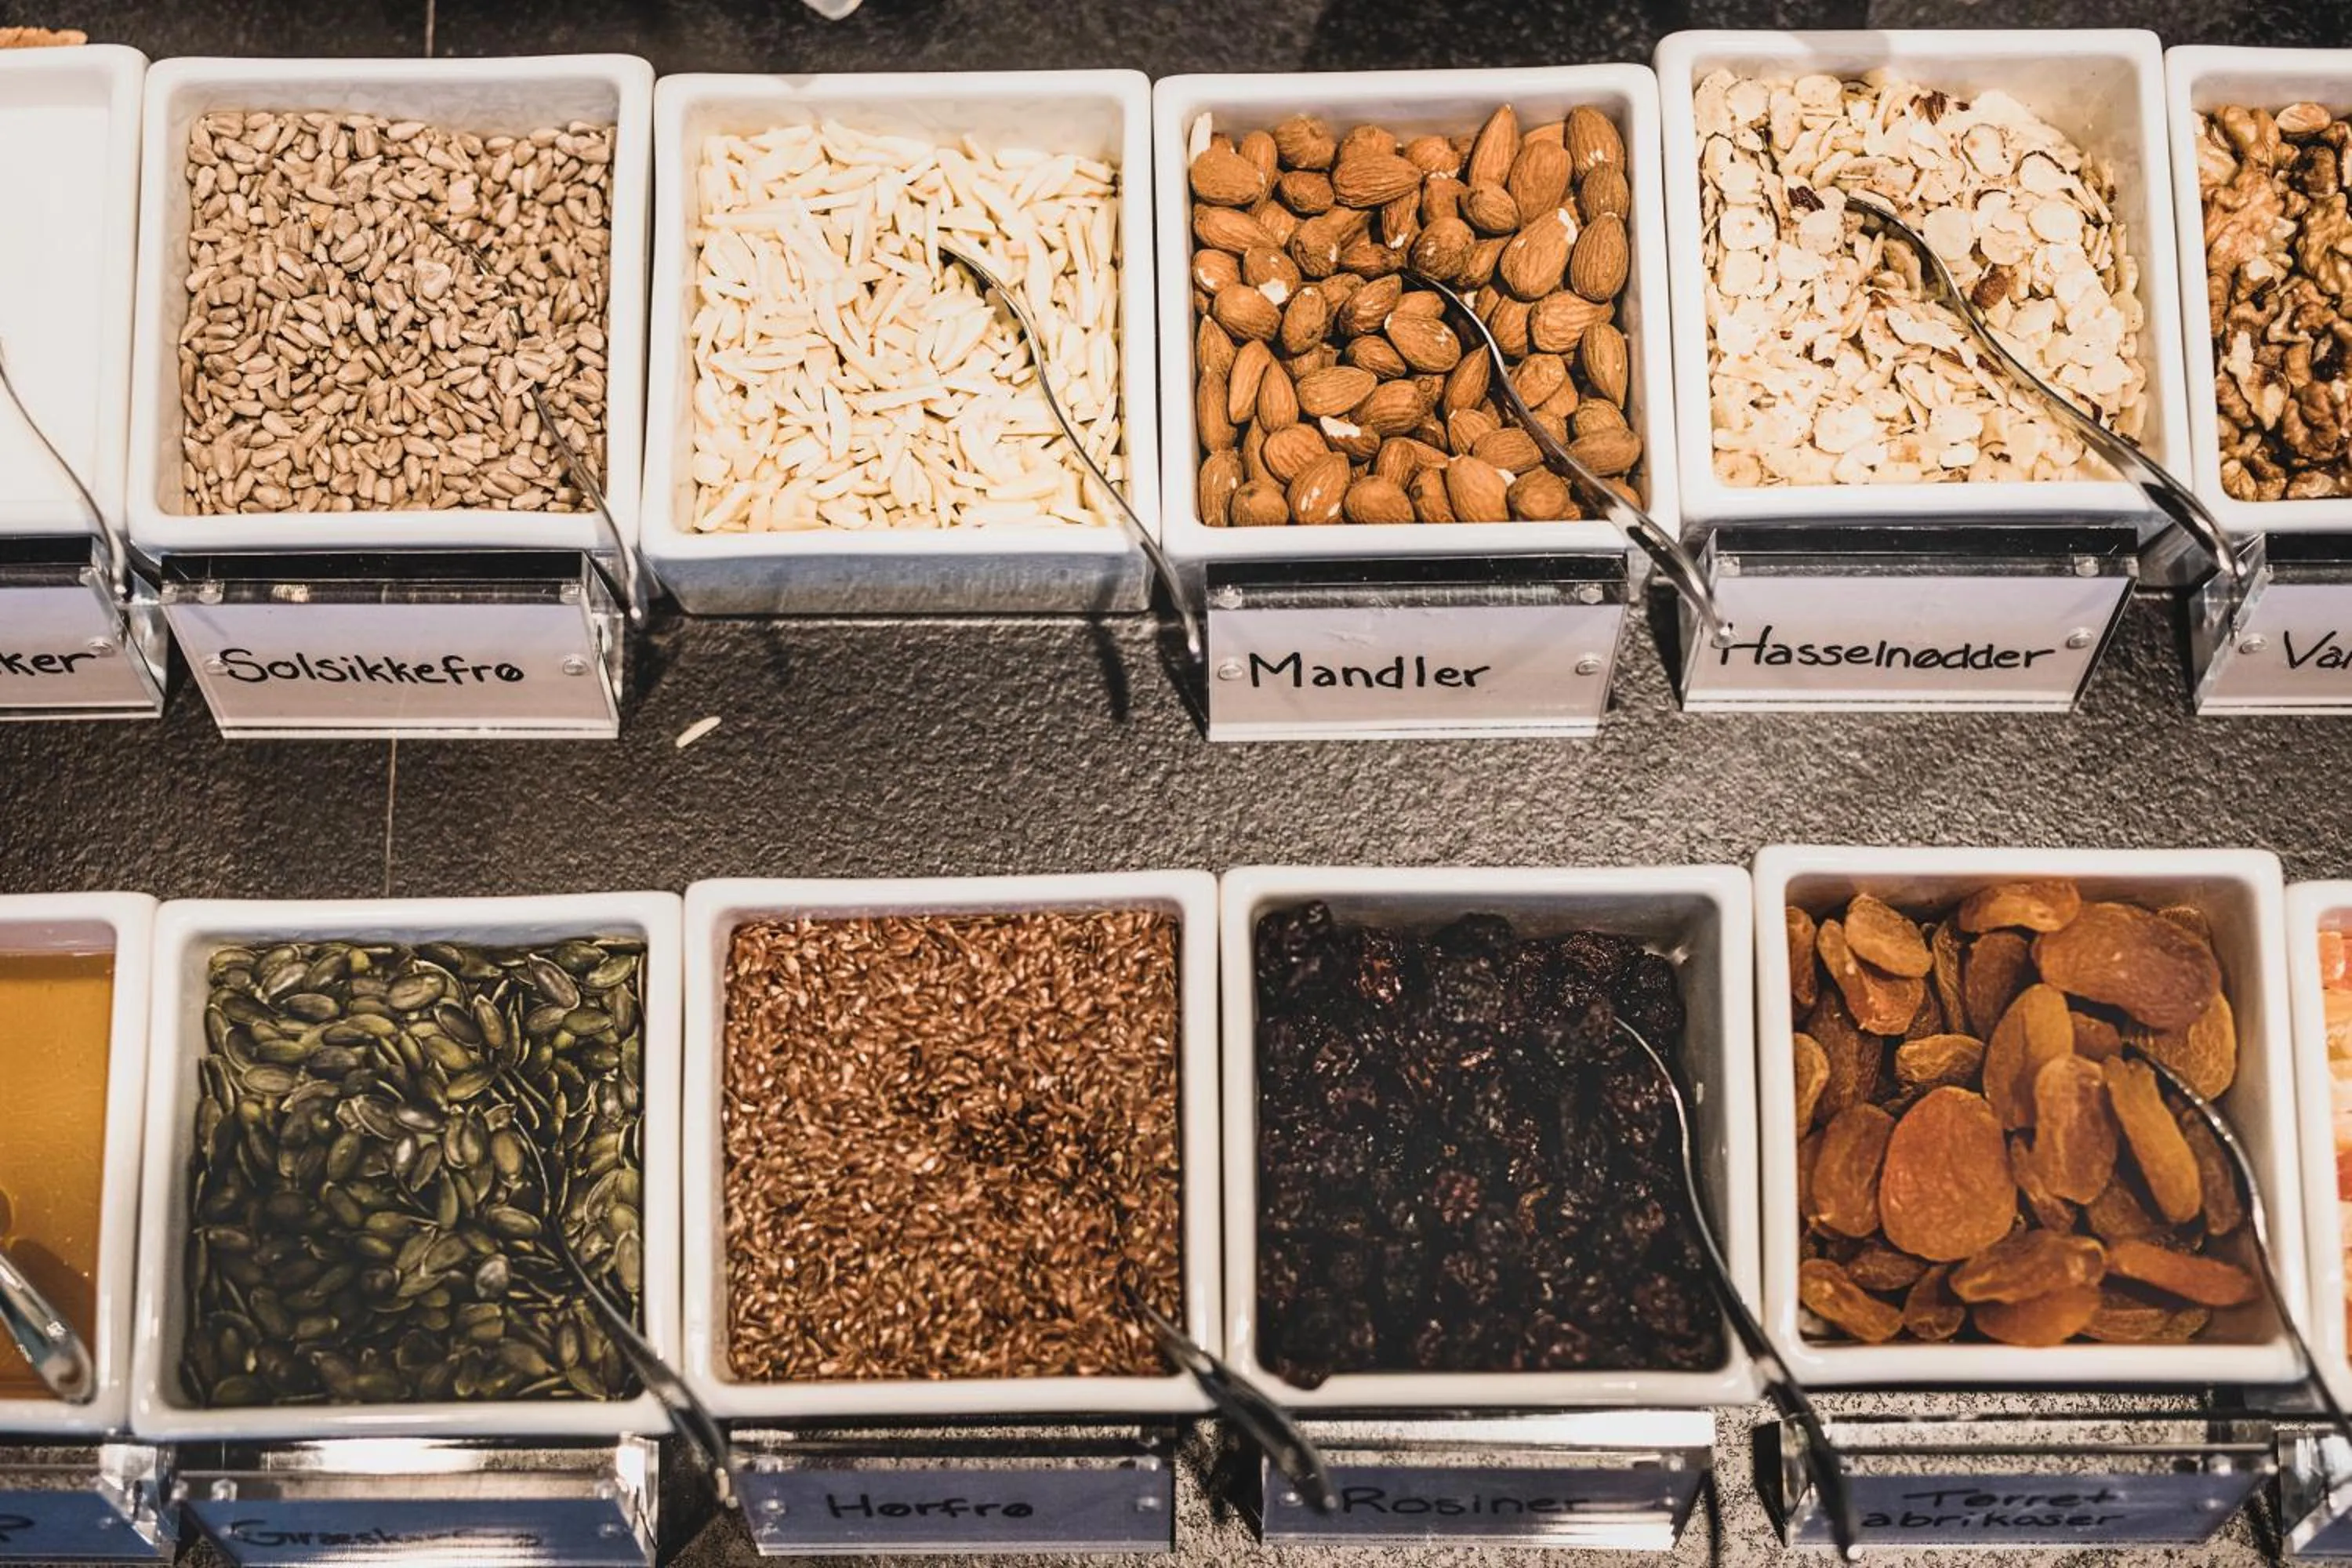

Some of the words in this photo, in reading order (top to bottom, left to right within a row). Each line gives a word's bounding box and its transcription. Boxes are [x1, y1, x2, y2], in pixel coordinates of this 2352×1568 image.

[1719, 624, 2056, 669] Hasselnødder
[0, 652, 96, 677] ker
[219, 648, 524, 685] Solsikkefrø
[1248, 652, 1491, 690] Mandler
[826, 1494, 1034, 1519] Hørfrø
[1341, 1487, 1589, 1515] Rosiner
[1901, 1488, 2118, 1508] Tørret
[1860, 1510, 2126, 1528] abrikoser
